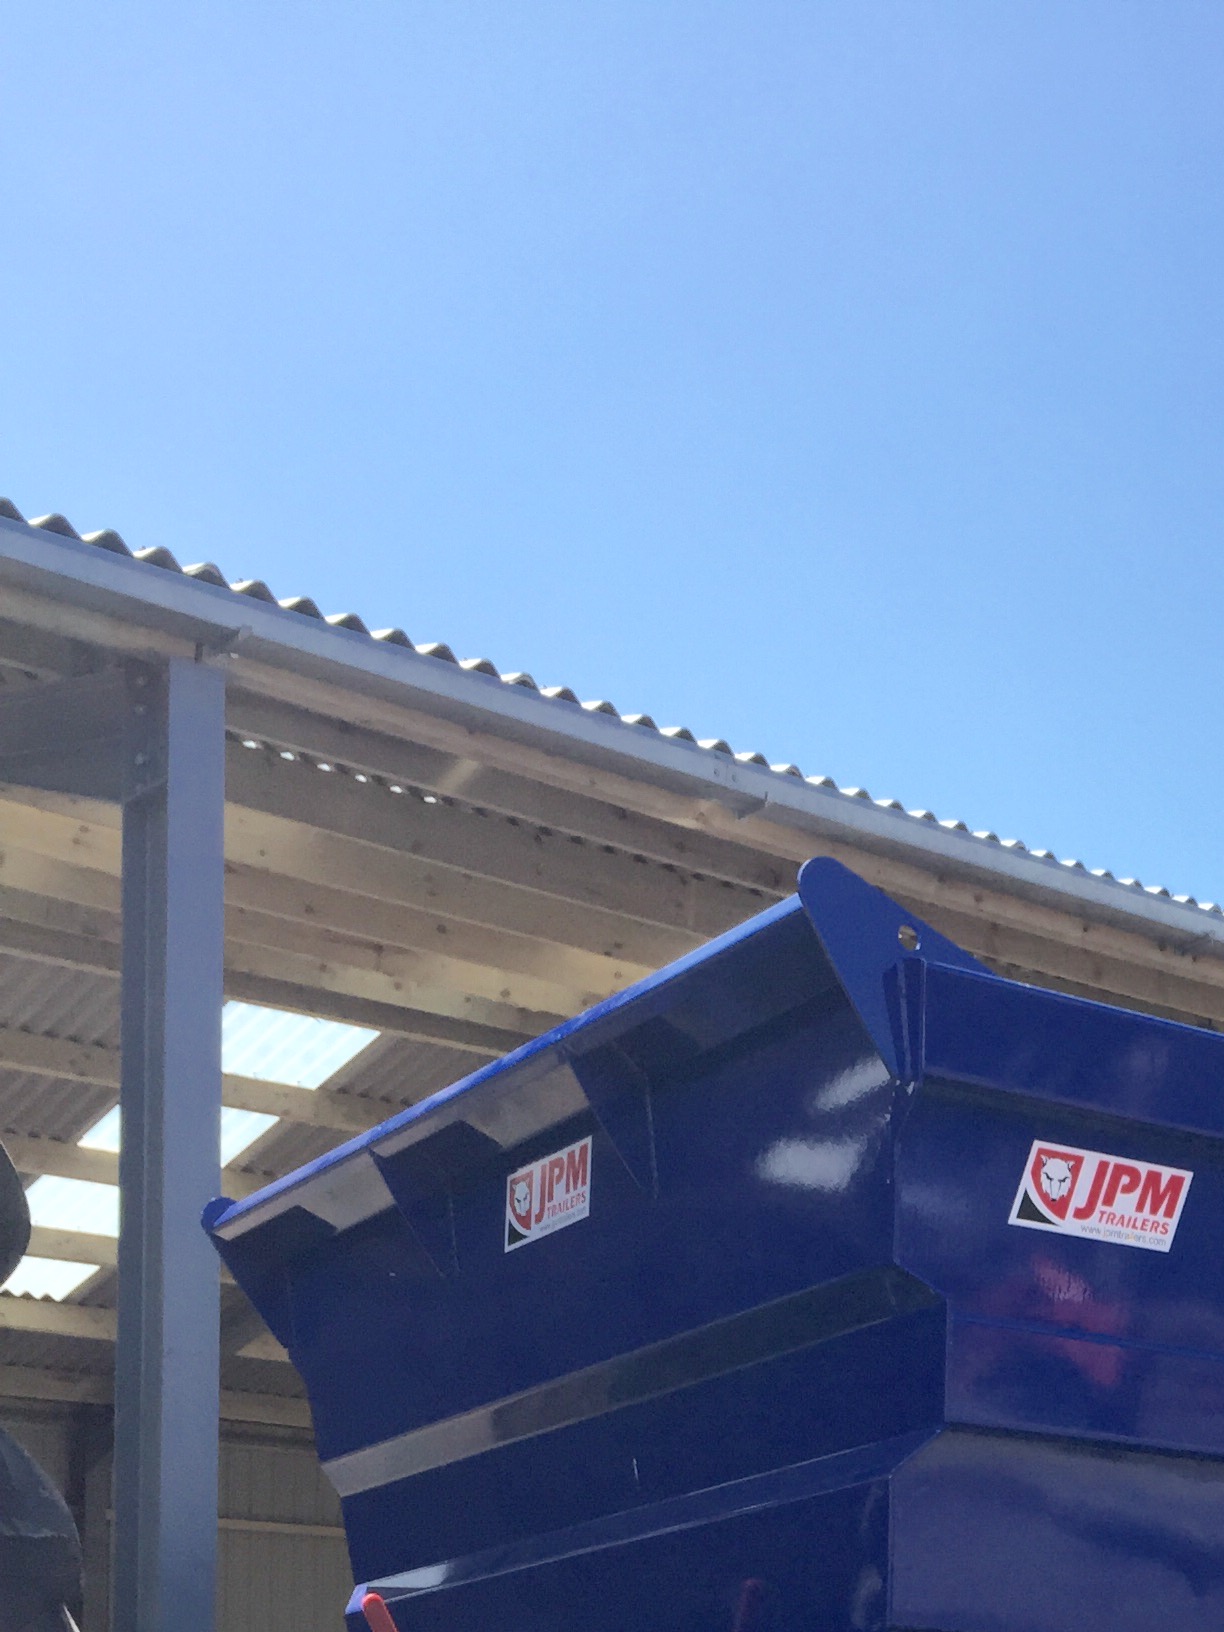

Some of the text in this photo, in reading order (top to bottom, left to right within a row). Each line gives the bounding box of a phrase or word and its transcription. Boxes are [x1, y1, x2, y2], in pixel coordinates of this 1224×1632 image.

[535, 1143, 588, 1224] JPM
[548, 1191, 586, 1218] TRAILERS
[1072, 1160, 1186, 1220] JPM
[1099, 1210, 1169, 1235] TRAILERS
